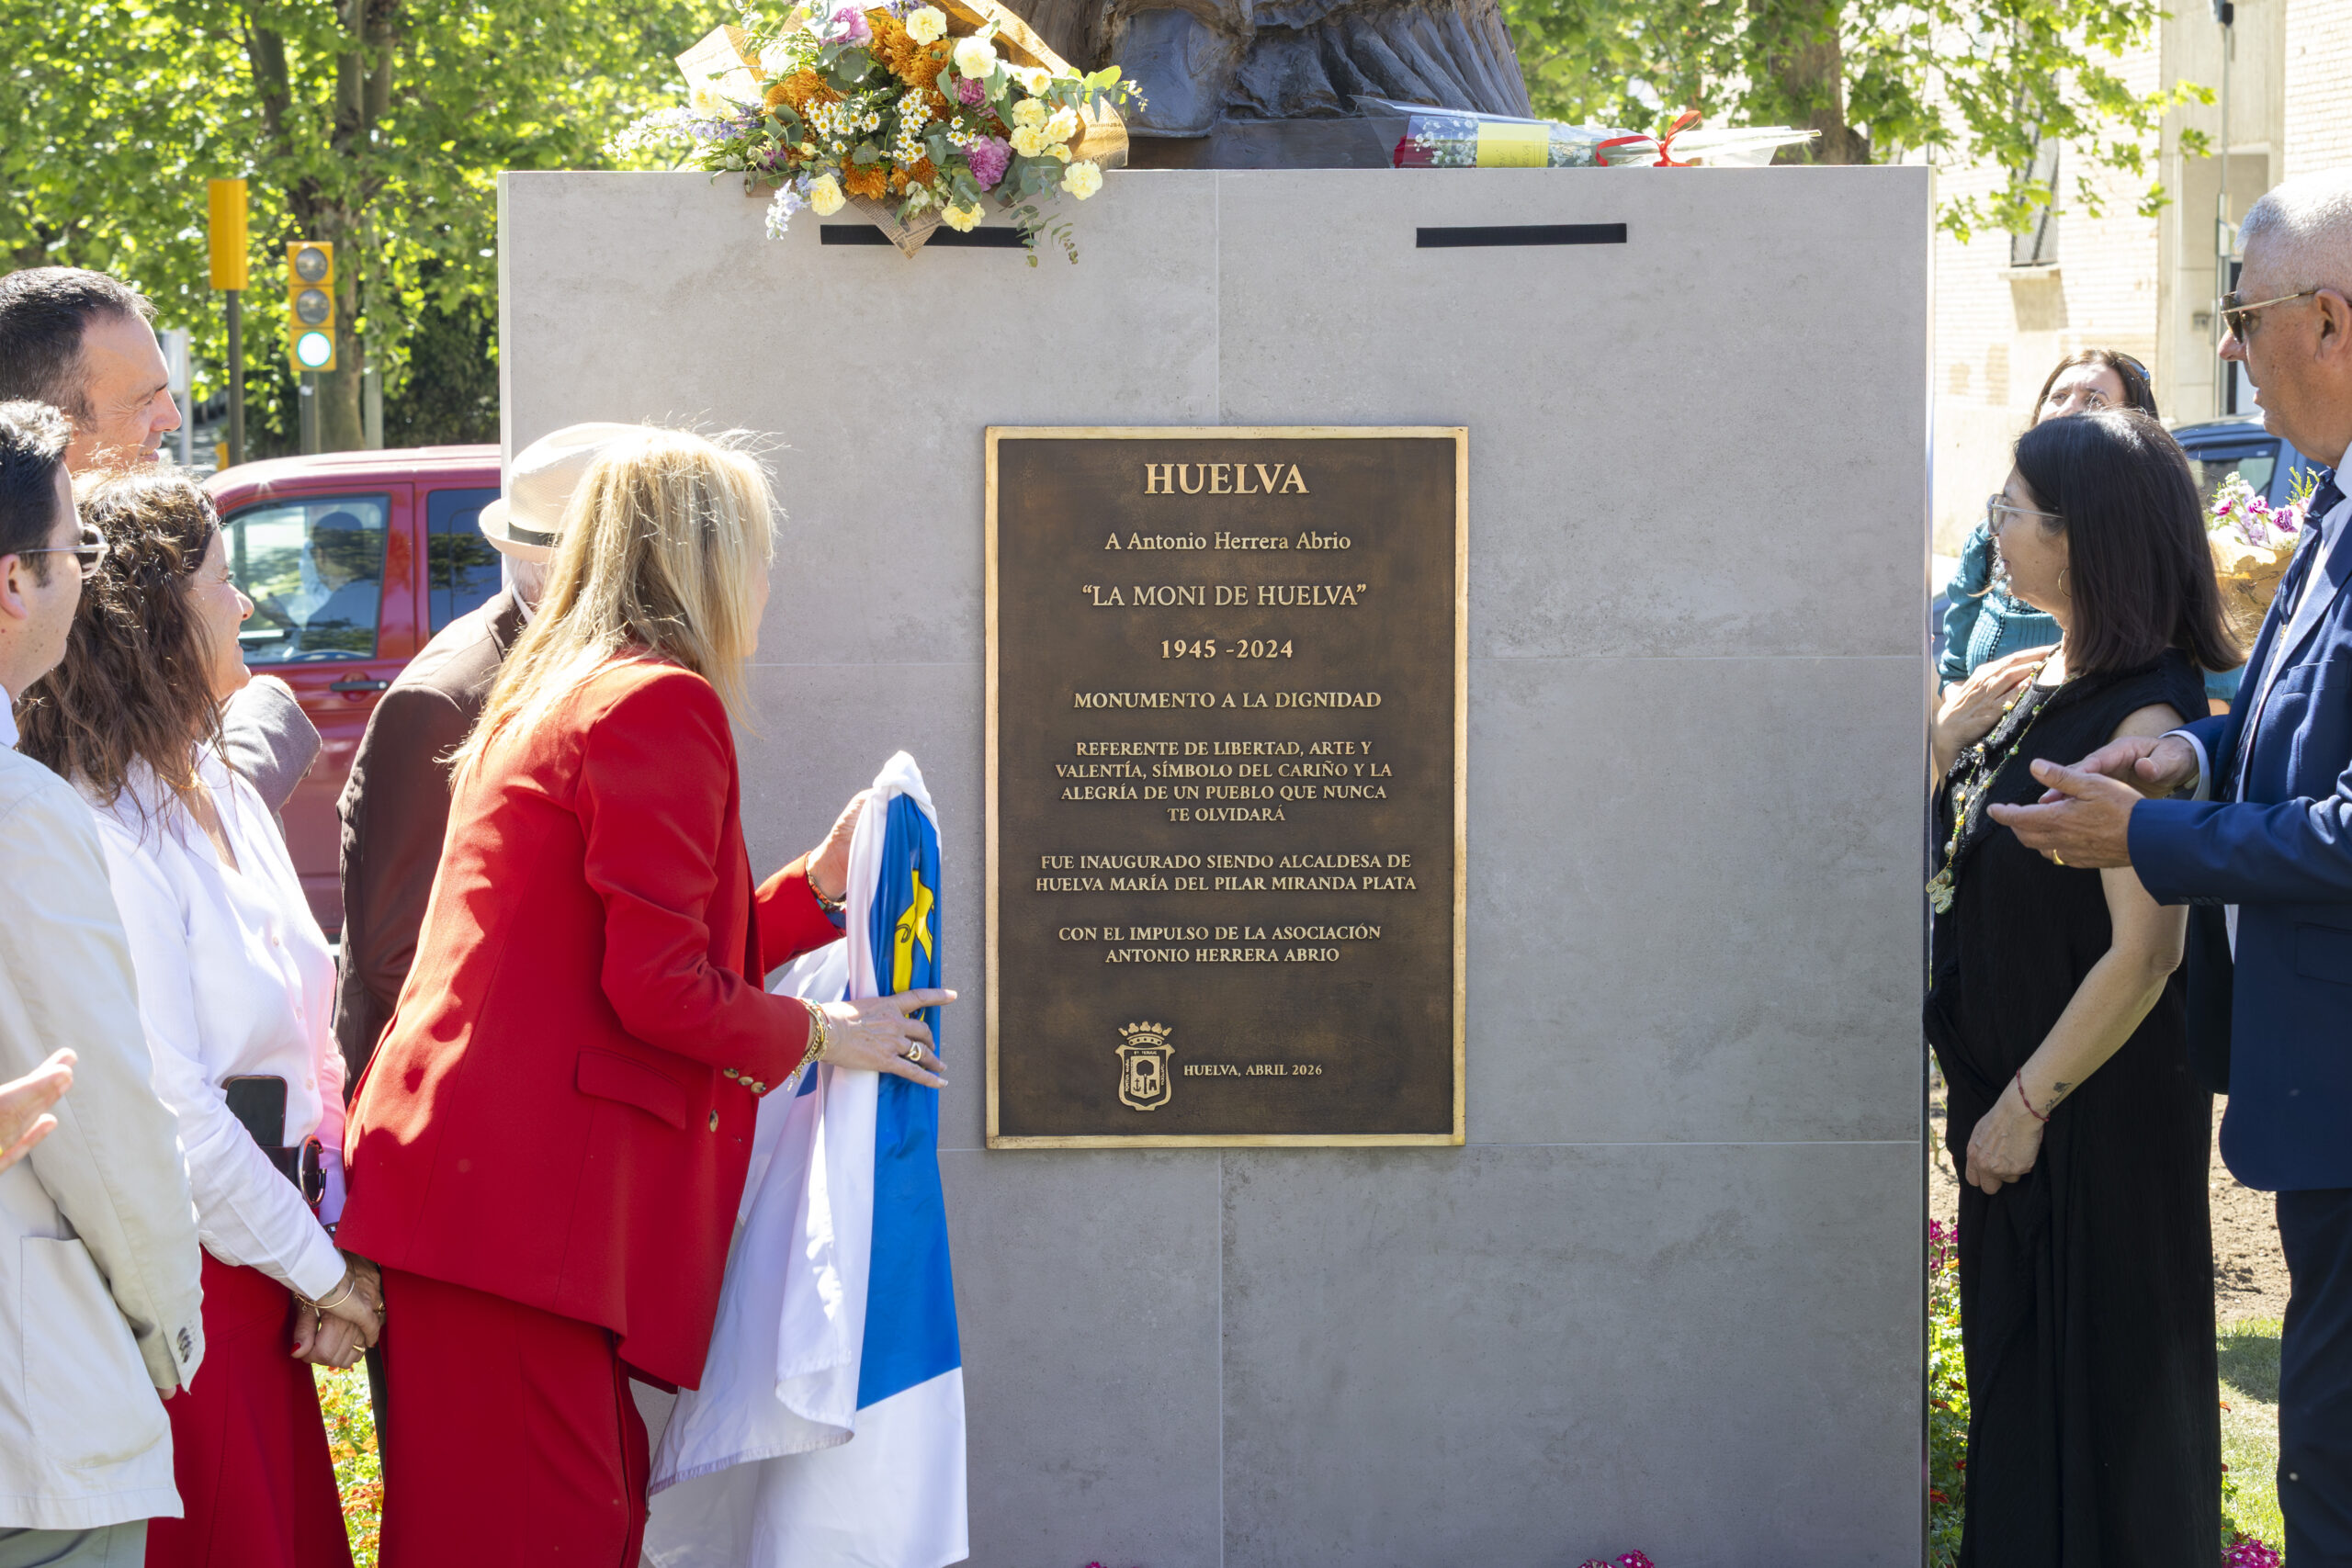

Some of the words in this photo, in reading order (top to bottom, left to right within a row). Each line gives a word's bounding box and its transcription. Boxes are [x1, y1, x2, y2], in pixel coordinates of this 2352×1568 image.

[1144, 463, 1310, 495] HUELVA
[1104, 532, 1122, 550] A
[1126, 531, 1207, 550] Antonio
[1214, 531, 1289, 550] Herrera
[1295, 530, 1351, 550] Abrio
[1132, 585, 1206, 606] MONI
[1215, 585, 1249, 606] DE
[1160, 638, 1216, 659] 1945
[1073, 692, 1216, 708] MONUMENTO
[1220, 692, 1237, 708] A
[1242, 692, 1269, 708] LA
[1274, 692, 1382, 708] DIGNIDAD
[1076, 741, 1180, 756] REFERENTE
[1184, 741, 1209, 756] DE
[1213, 741, 1304, 758] LIBERTAD,
[1308, 741, 1356, 755] ARTE
[1360, 740, 1373, 755] Y
[1055, 760, 1148, 780] VALENTÍA,
[1152, 760, 1233, 778] SÍMBOLO
[1238, 763, 1273, 778] DEL
[1278, 760, 1349, 777] CARIÑO
[1352, 762, 1365, 777] Y
[1370, 762, 1393, 777] LA
[1061, 782, 1138, 800] ALEGRÍA
[1144, 785, 1169, 800] DE
[1173, 785, 1200, 800] UN
[1204, 785, 1274, 800] PUEBLO
[1279, 784, 1317, 802] QUE
[1322, 784, 1387, 799] NUNCA
[1167, 807, 1191, 822] TE
[1194, 805, 1286, 822] OLVIDARÁ
[1041, 855, 1075, 870] FUE
[1080, 854, 1202, 869] INAUGURADO
[1206, 854, 1274, 869] SIENDO
[1278, 853, 1383, 869] ALCALDESA
[1386, 853, 1411, 868] DE
[1035, 877, 1104, 892] HUELVA
[1109, 874, 1170, 891] MARÍA
[1174, 876, 1209, 891] DEL
[1215, 876, 1266, 891] PILAR
[1271, 875, 1358, 890] MIRANDA
[1363, 875, 1417, 890] PLATA
[1058, 927, 1098, 942] CON
[1102, 927, 1125, 942] EL
[1129, 926, 1209, 941] IMPULSO
[1215, 926, 1239, 941] DE
[1244, 926, 1267, 941] LA
[1271, 922, 1382, 941] ASOCIACIÓN
[1104, 948, 1190, 964] ANTONIO
[1195, 947, 1280, 963] HERRERA
[1283, 947, 1340, 962] ABRIO
[1183, 1064, 1241, 1077] HUELVA,
[1245, 1064, 1288, 1076] ABRIL
[1292, 1064, 1323, 1076] 2026
